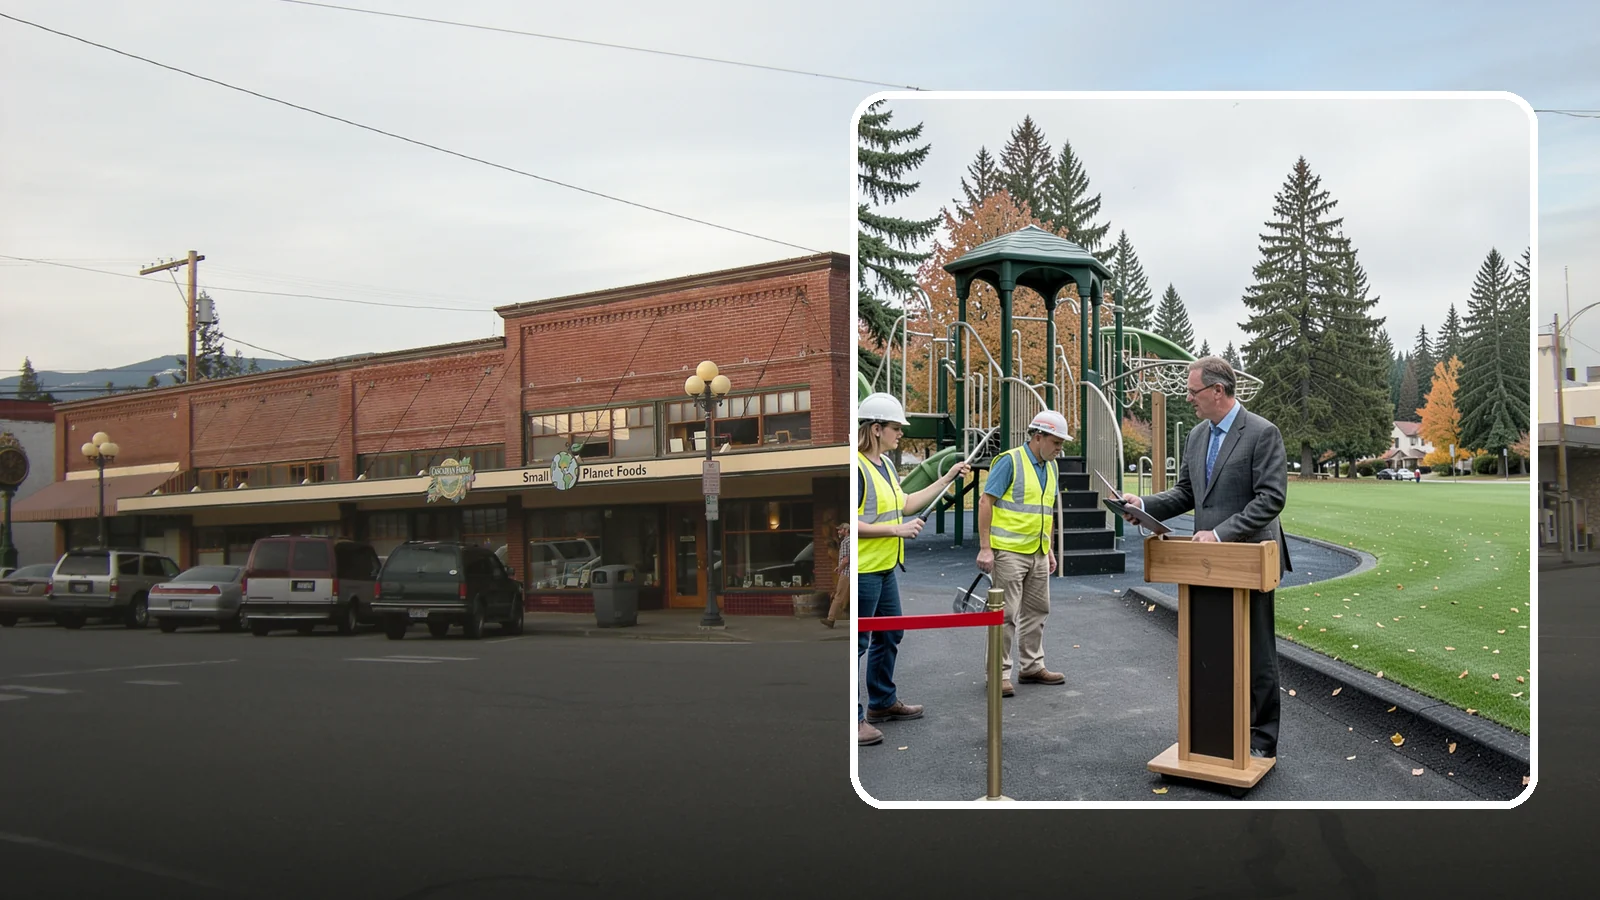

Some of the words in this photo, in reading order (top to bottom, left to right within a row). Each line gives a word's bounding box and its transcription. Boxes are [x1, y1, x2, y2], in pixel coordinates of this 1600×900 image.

[431, 466, 456, 476] CASCADIAN
[523, 471, 549, 483] Small
[583, 467, 614, 479] Planet
[617, 465, 647, 477] Foods
